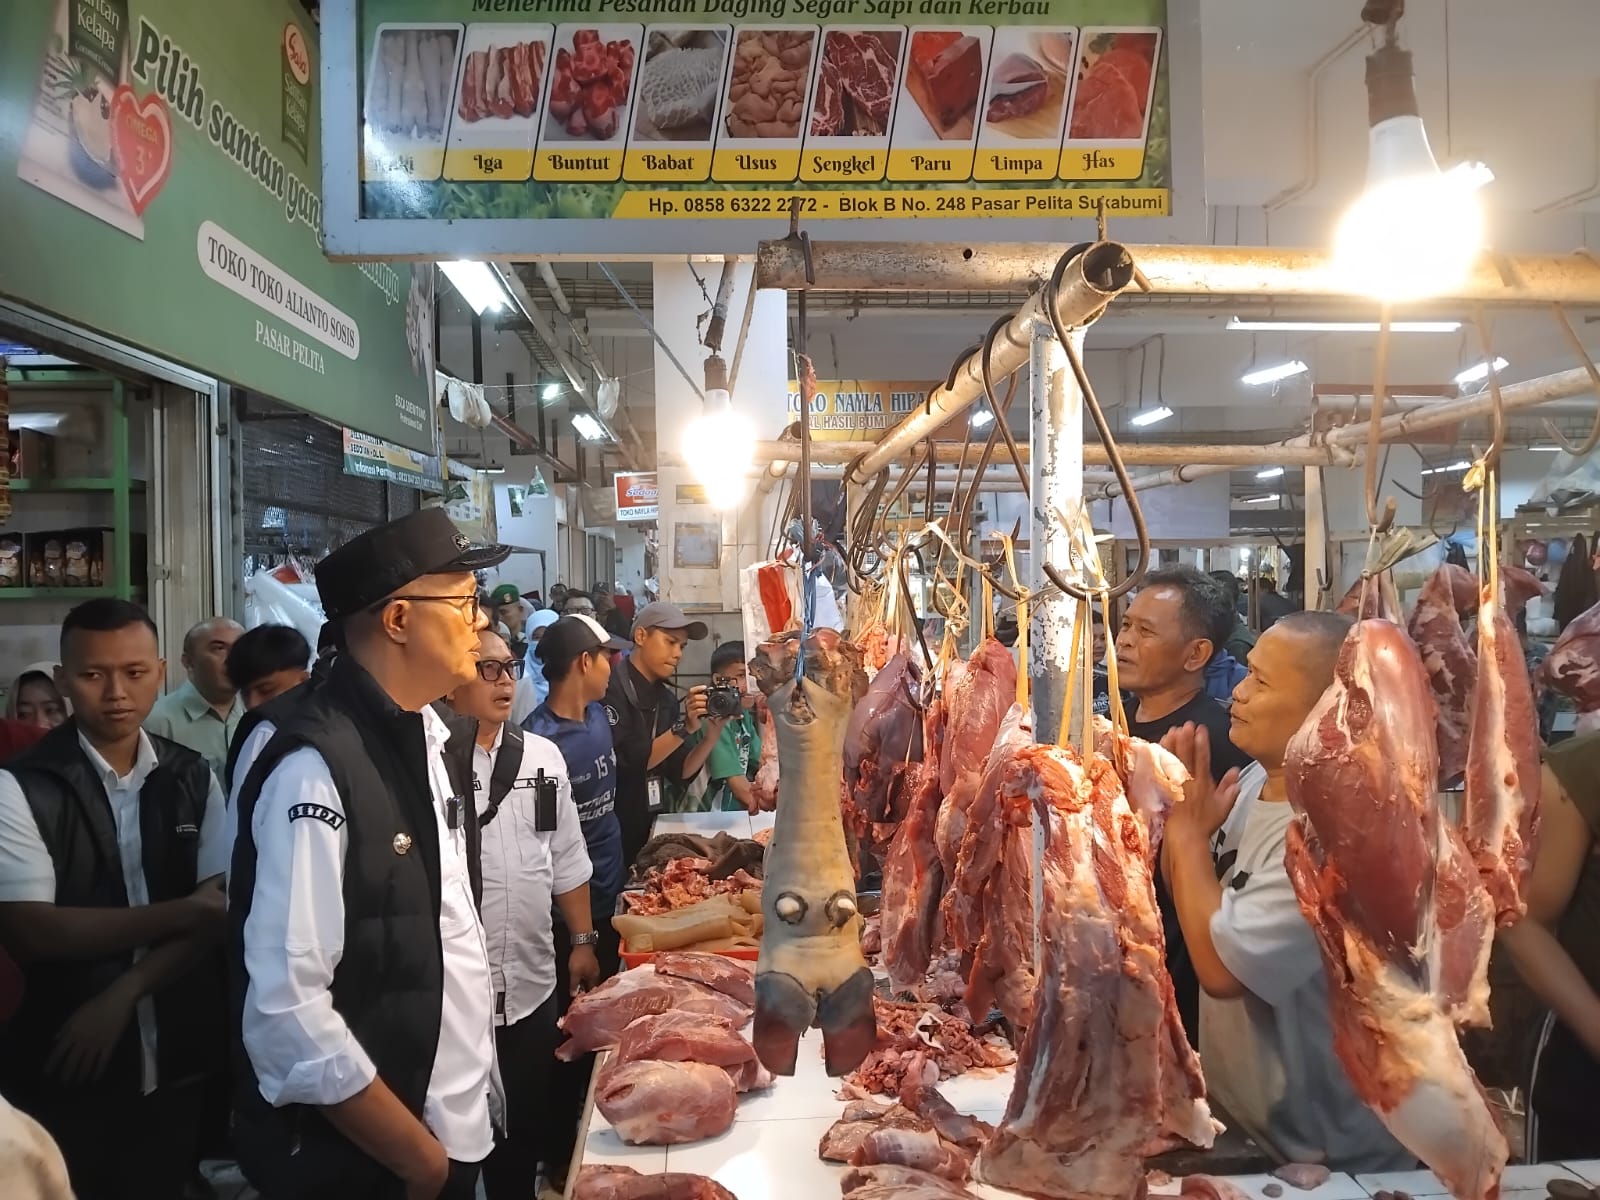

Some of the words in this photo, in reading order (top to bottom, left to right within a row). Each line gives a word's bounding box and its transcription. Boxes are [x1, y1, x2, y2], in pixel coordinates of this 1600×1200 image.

[84, 0, 119, 31] ntan
[471, 0, 591, 13] Menerima
[597, 0, 698, 13] Pesanan
[703, 0, 785, 18] Daging
[792, 0, 853, 19] Segar
[864, 0, 912, 19] Sapi
[919, 0, 961, 14] dan
[968, 0, 1050, 15] Kerbau
[78, 3, 115, 52] Kelapa
[132, 17, 204, 127] Pilih
[208, 103, 284, 199] santan
[473, 154, 503, 170] Iga
[547, 154, 611, 171] Buntut
[641, 154, 695, 171] Babat
[735, 155, 777, 170] Usus
[812, 155, 875, 174] Sengkel
[910, 156, 952, 171] Paru
[990, 155, 1043, 174] Limpa
[1082, 150, 1115, 170] Has
[649, 198, 679, 213] Hp.
[684, 197, 725, 212] 0858
[730, 197, 771, 212] 6322
[839, 197, 878, 212] Blok
[883, 196, 896, 211] B
[902, 196, 930, 211] No.
[936, 196, 966, 211] 248
[972, 196, 1020, 211] Pasar
[1026, 195, 1073, 210] Pelita
[208, 236, 247, 281] TOKO
[250, 264, 283, 304] TOKO
[285, 288, 329, 332] ALIANTO
[330, 317, 355, 349] SOSIS
[256, 320, 291, 358] PASAR
[293, 340, 325, 375] PELITA
[788, 393, 826, 412] TOO
[835, 393, 882, 412] NAYLA
[891, 393, 927, 412] HIPA
[823, 415, 856, 429] HASIL
[858, 415, 888, 429] BUMI
[594, 755, 609, 780] 15
